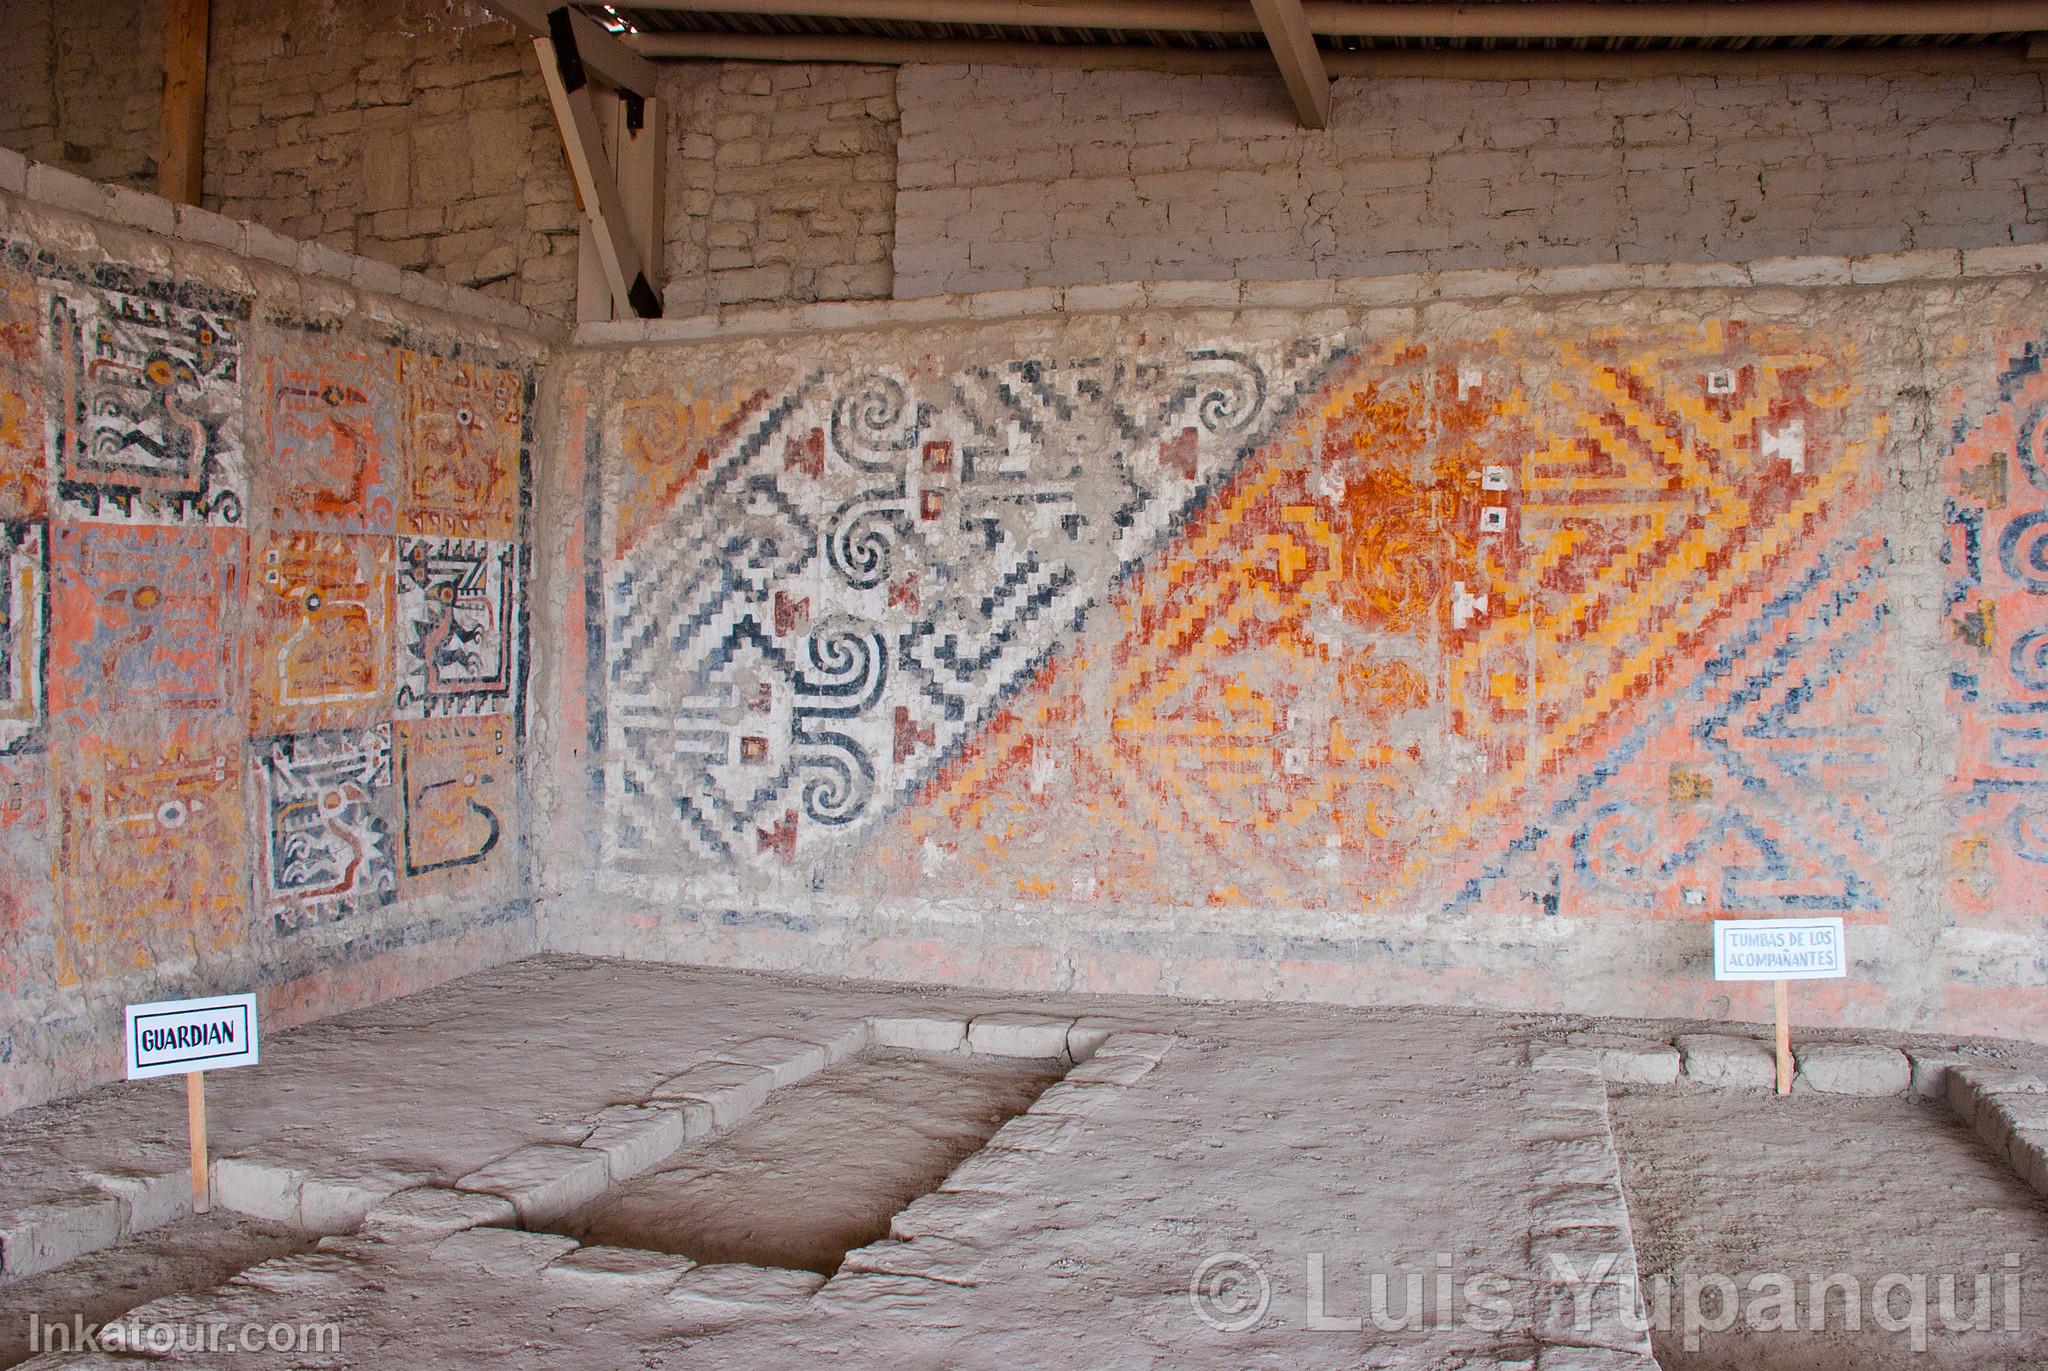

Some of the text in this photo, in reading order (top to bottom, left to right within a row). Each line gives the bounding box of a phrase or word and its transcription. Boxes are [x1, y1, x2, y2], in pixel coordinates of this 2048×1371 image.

[1729, 930, 1832, 947] TUMBAS DE LOS
[1729, 949, 1834, 967] ACOMPAÑANTES
[142, 1020, 234, 1051] GUARDIAN
